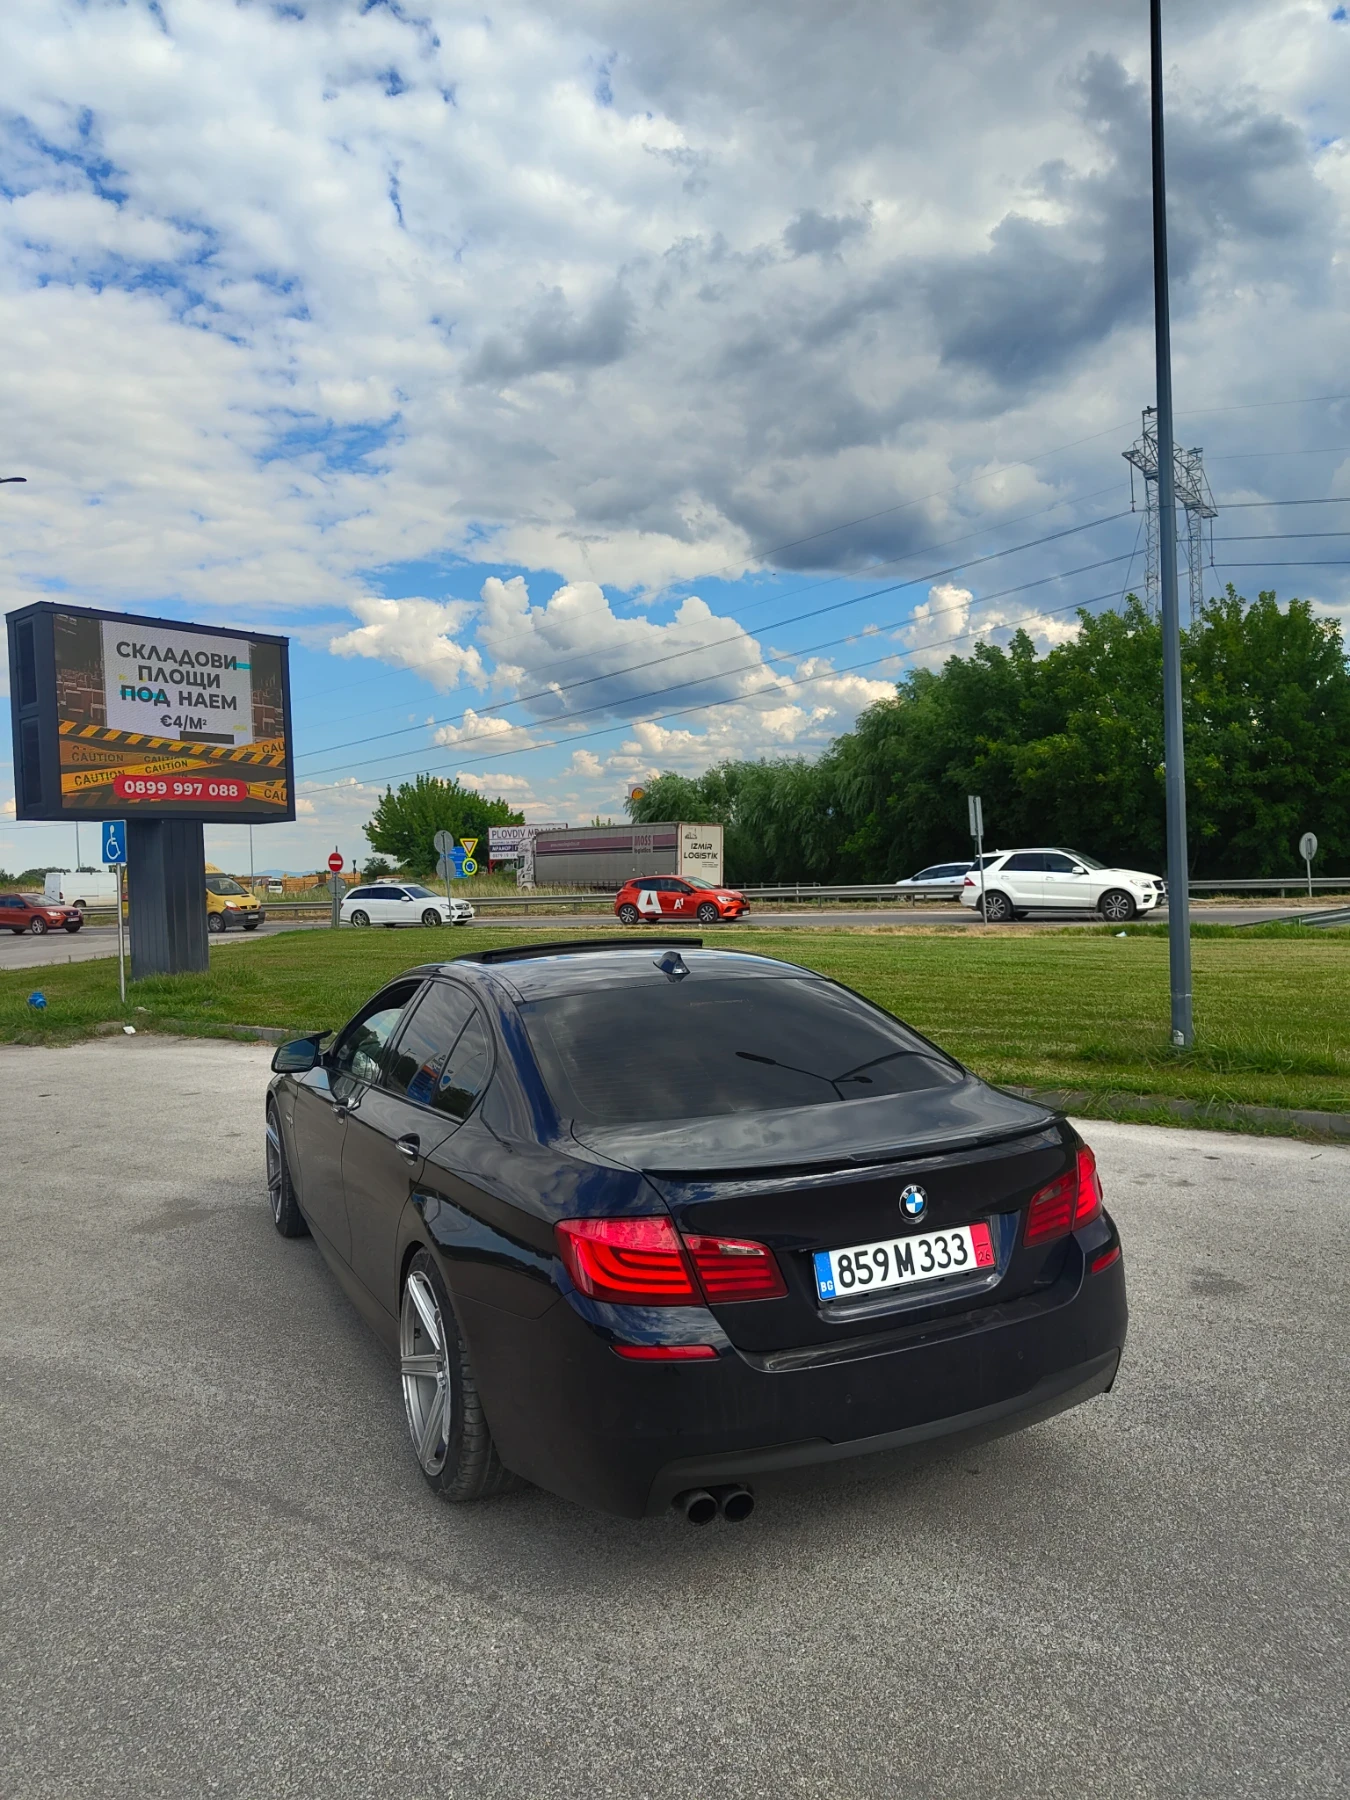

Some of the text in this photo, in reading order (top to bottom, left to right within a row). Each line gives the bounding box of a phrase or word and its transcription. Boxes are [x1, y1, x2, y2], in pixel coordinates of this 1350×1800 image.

[116, 641, 237, 671] СКЛАДОВИ
[138, 665, 220, 690] ПЛОЩИ
[120, 684, 237, 711] ПОД НАЕМ
[71, 751, 124, 763] CAUTION
[145, 759, 188, 774] CAUTION
[74, 769, 126, 787] CAUTION
[124, 780, 167, 795] 0899
[173, 782, 203, 796] 997
[208, 783, 239, 797] 088
[491, 828, 526, 839] PLOVDIV
[978, 1250, 991, 1262] 26
[820, 1280, 834, 1292] BG
